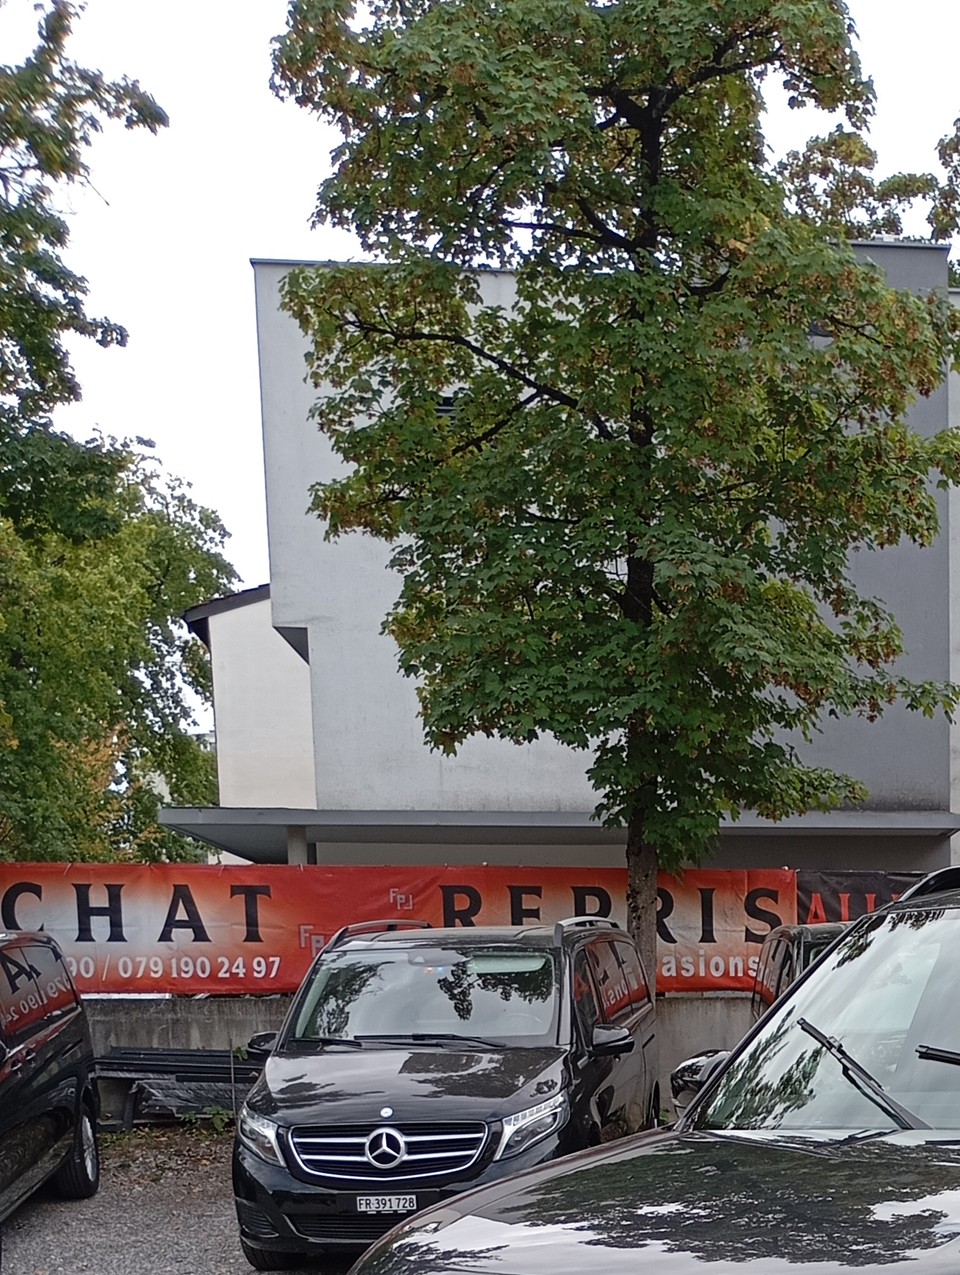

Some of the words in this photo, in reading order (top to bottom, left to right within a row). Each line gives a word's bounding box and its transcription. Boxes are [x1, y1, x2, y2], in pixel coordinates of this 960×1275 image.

[1, 882, 272, 943] CHAT
[117, 956, 164, 979] 079
[171, 956, 211, 979] 190
[217, 956, 246, 979] 24
[252, 956, 281, 979] 97
